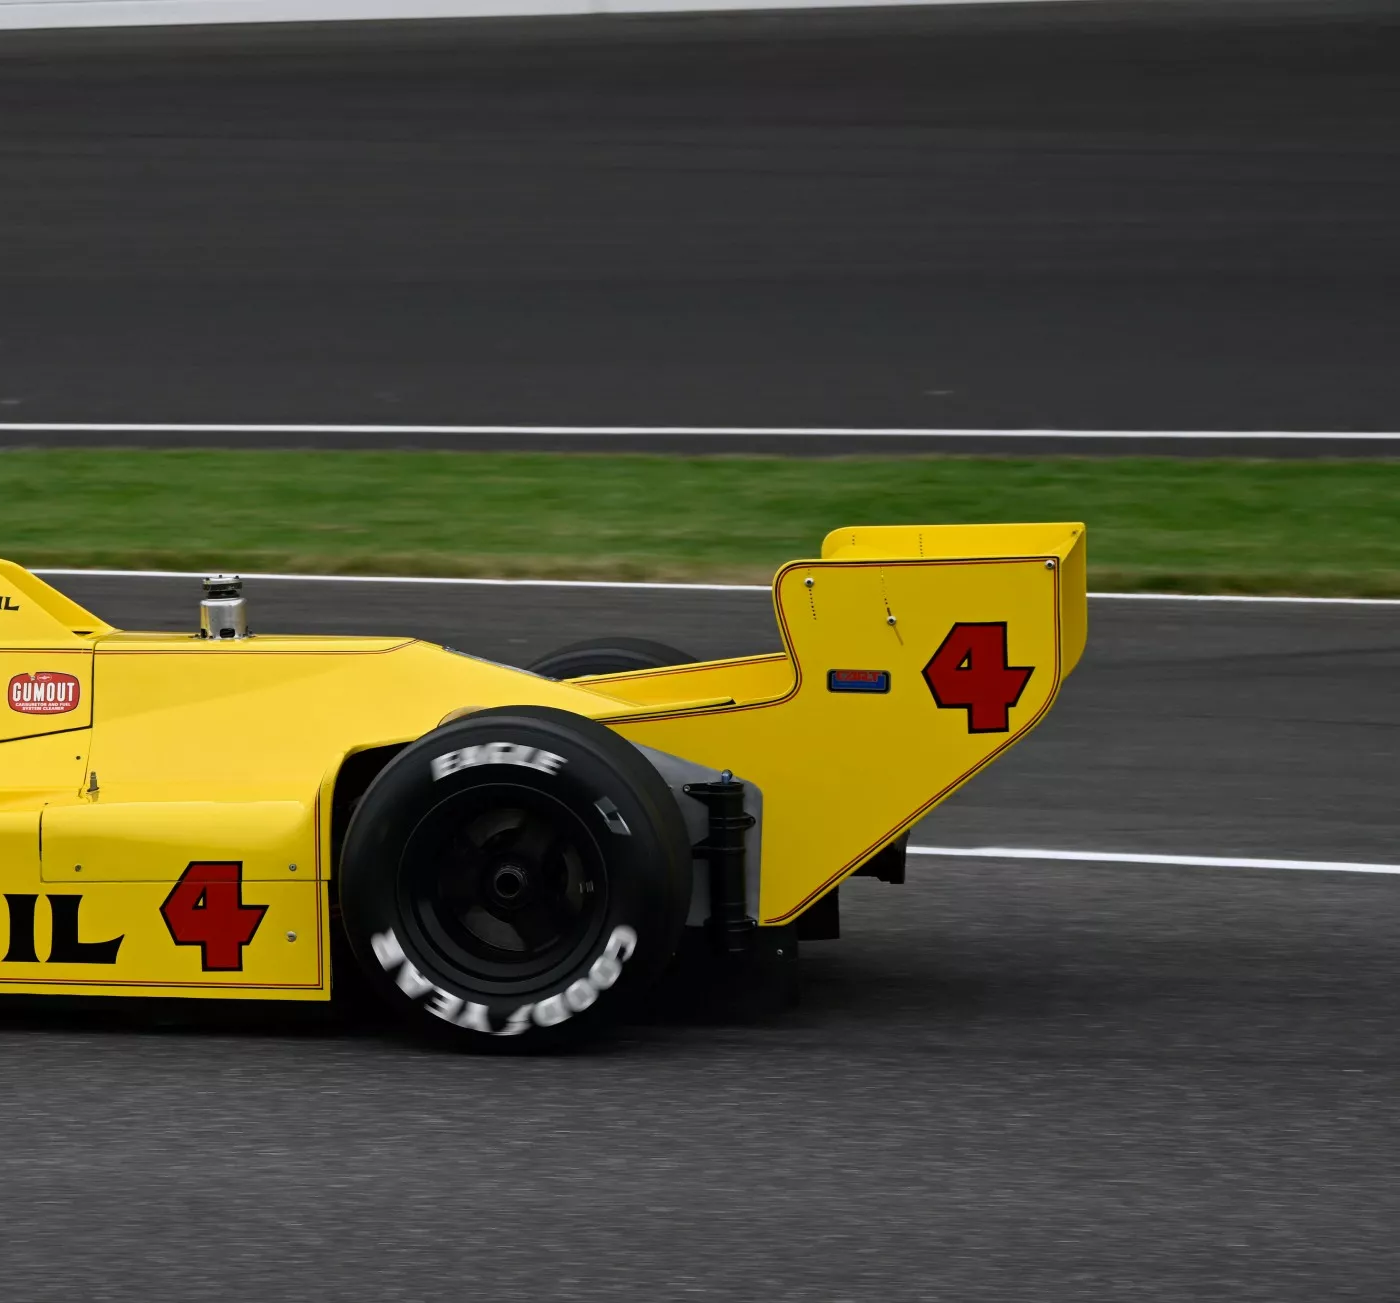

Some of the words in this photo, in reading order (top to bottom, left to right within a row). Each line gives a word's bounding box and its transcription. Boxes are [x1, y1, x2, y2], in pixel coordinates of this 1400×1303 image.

[12, 682, 75, 702] GUMOUT
[921, 621, 1036, 734] 4
[159, 860, 270, 973] 4
[370, 924, 638, 1036] GOODYEAR
